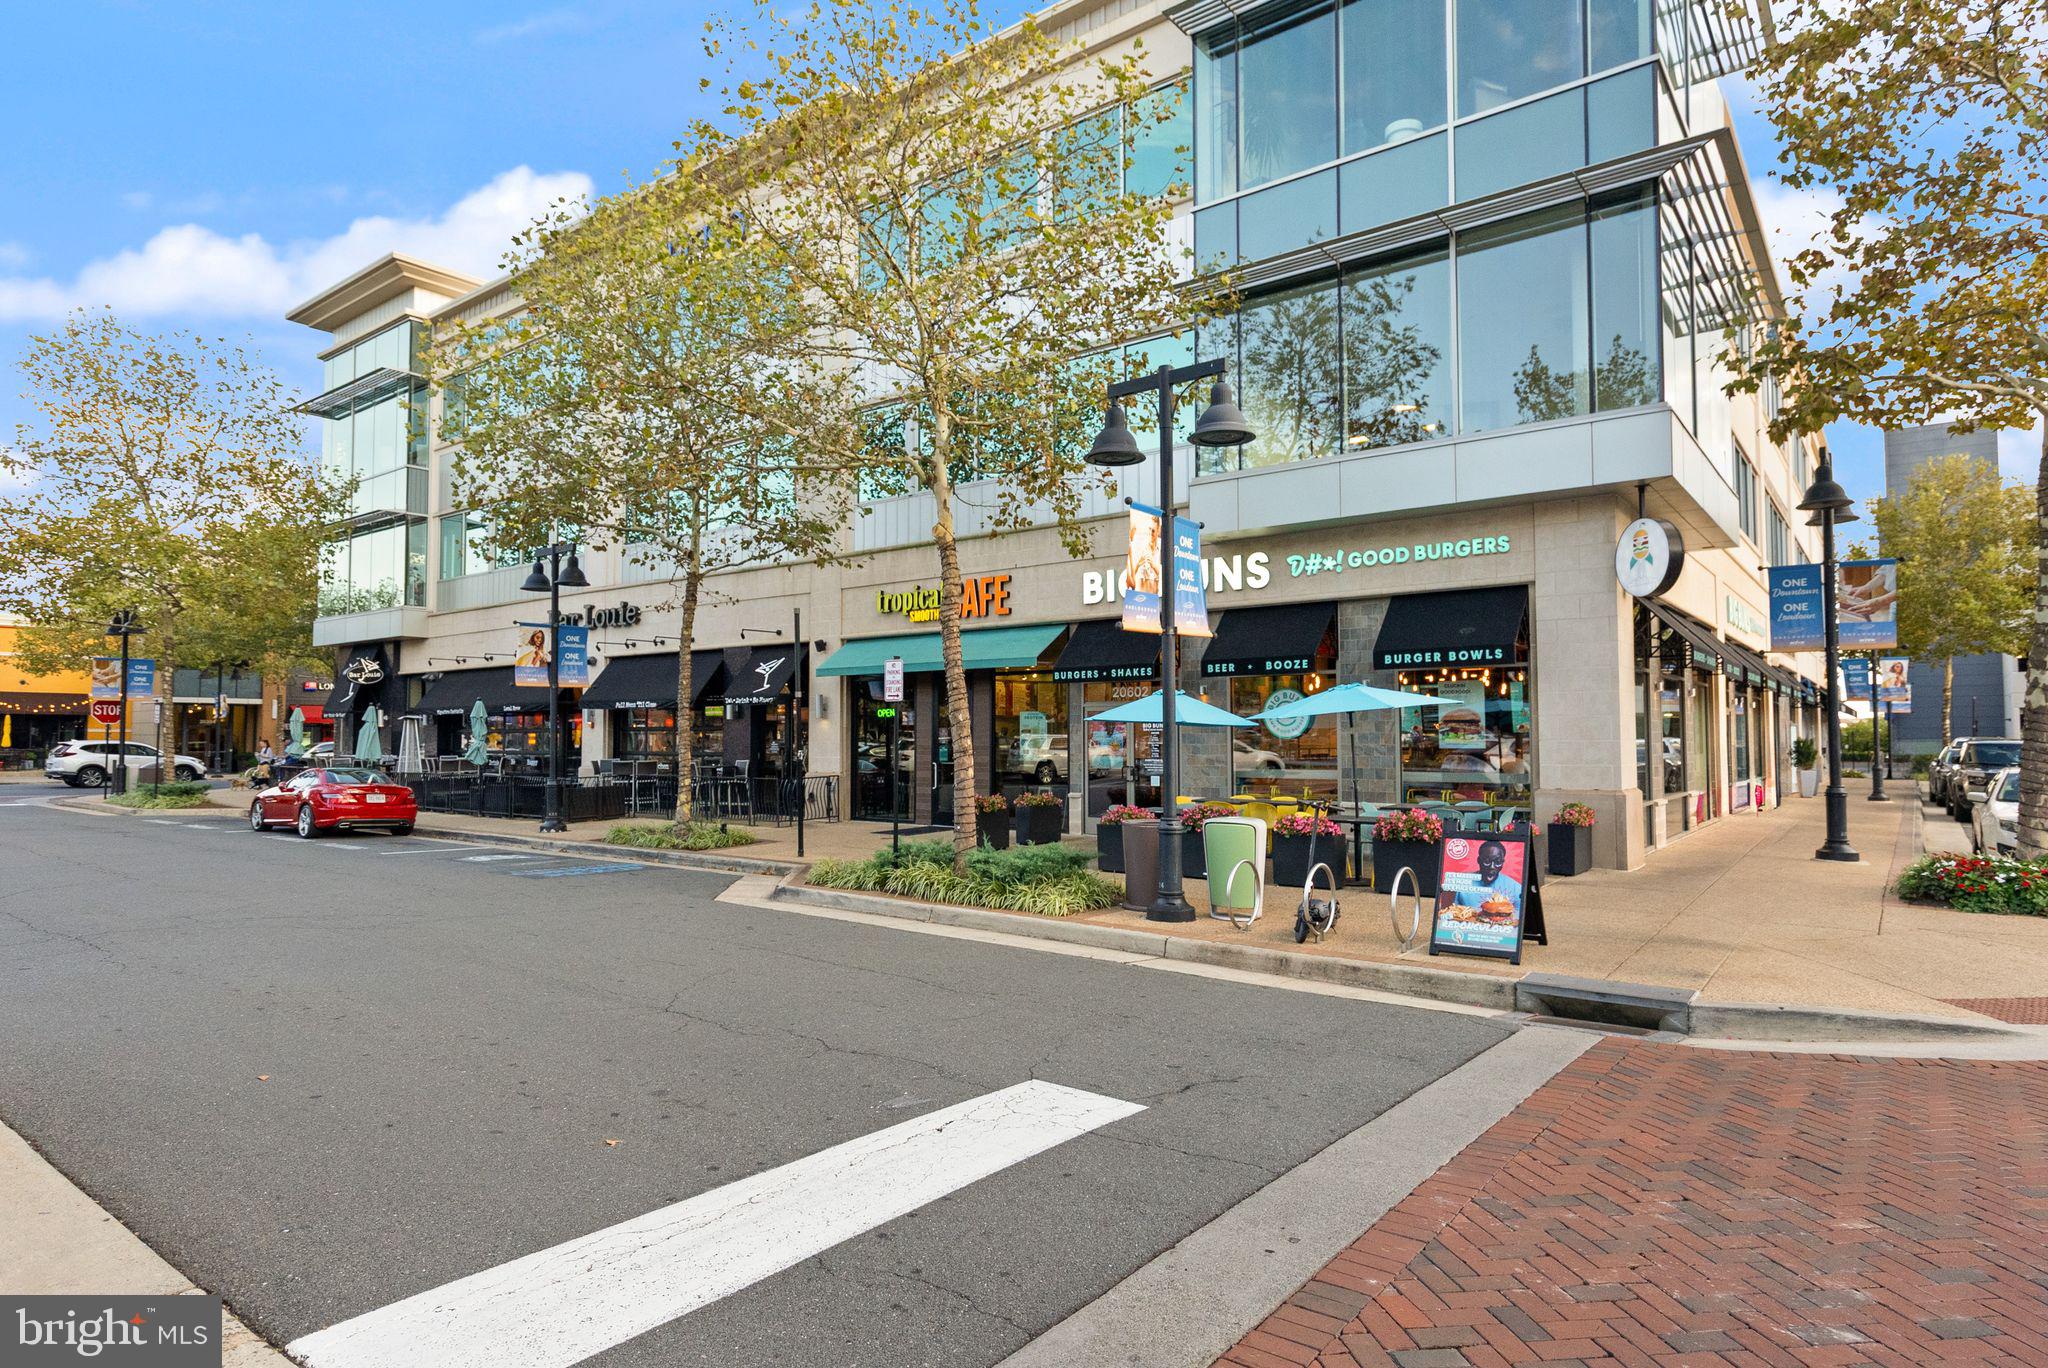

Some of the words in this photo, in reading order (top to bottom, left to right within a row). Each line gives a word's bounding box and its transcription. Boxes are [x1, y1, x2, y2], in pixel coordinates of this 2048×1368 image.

[1179, 535, 1194, 549] ONE
[1347, 547, 1410, 568] GOOD
[1414, 535, 1511, 562] BURGERS
[1179, 568, 1194, 583] ONE
[1782, 578, 1808, 587] ONE
[961, 575, 1010, 618] AFE
[1772, 588, 1819, 598] Downtown
[1783, 602, 1809, 612] ONE
[584, 601, 641, 630] Louie
[565, 635, 580, 643] ONE
[1384, 652, 1441, 664] BURGER
[1448, 649, 1503, 661] BOWLS
[1207, 663, 1235, 673] BEER
[1265, 659, 1309, 670] BOOZE
[1054, 670, 1099, 680] BURGERS
[1111, 667, 1153, 678] SHAKES
[1112, 686, 1149, 698] 20602
[877, 708, 896, 718] OPEN
